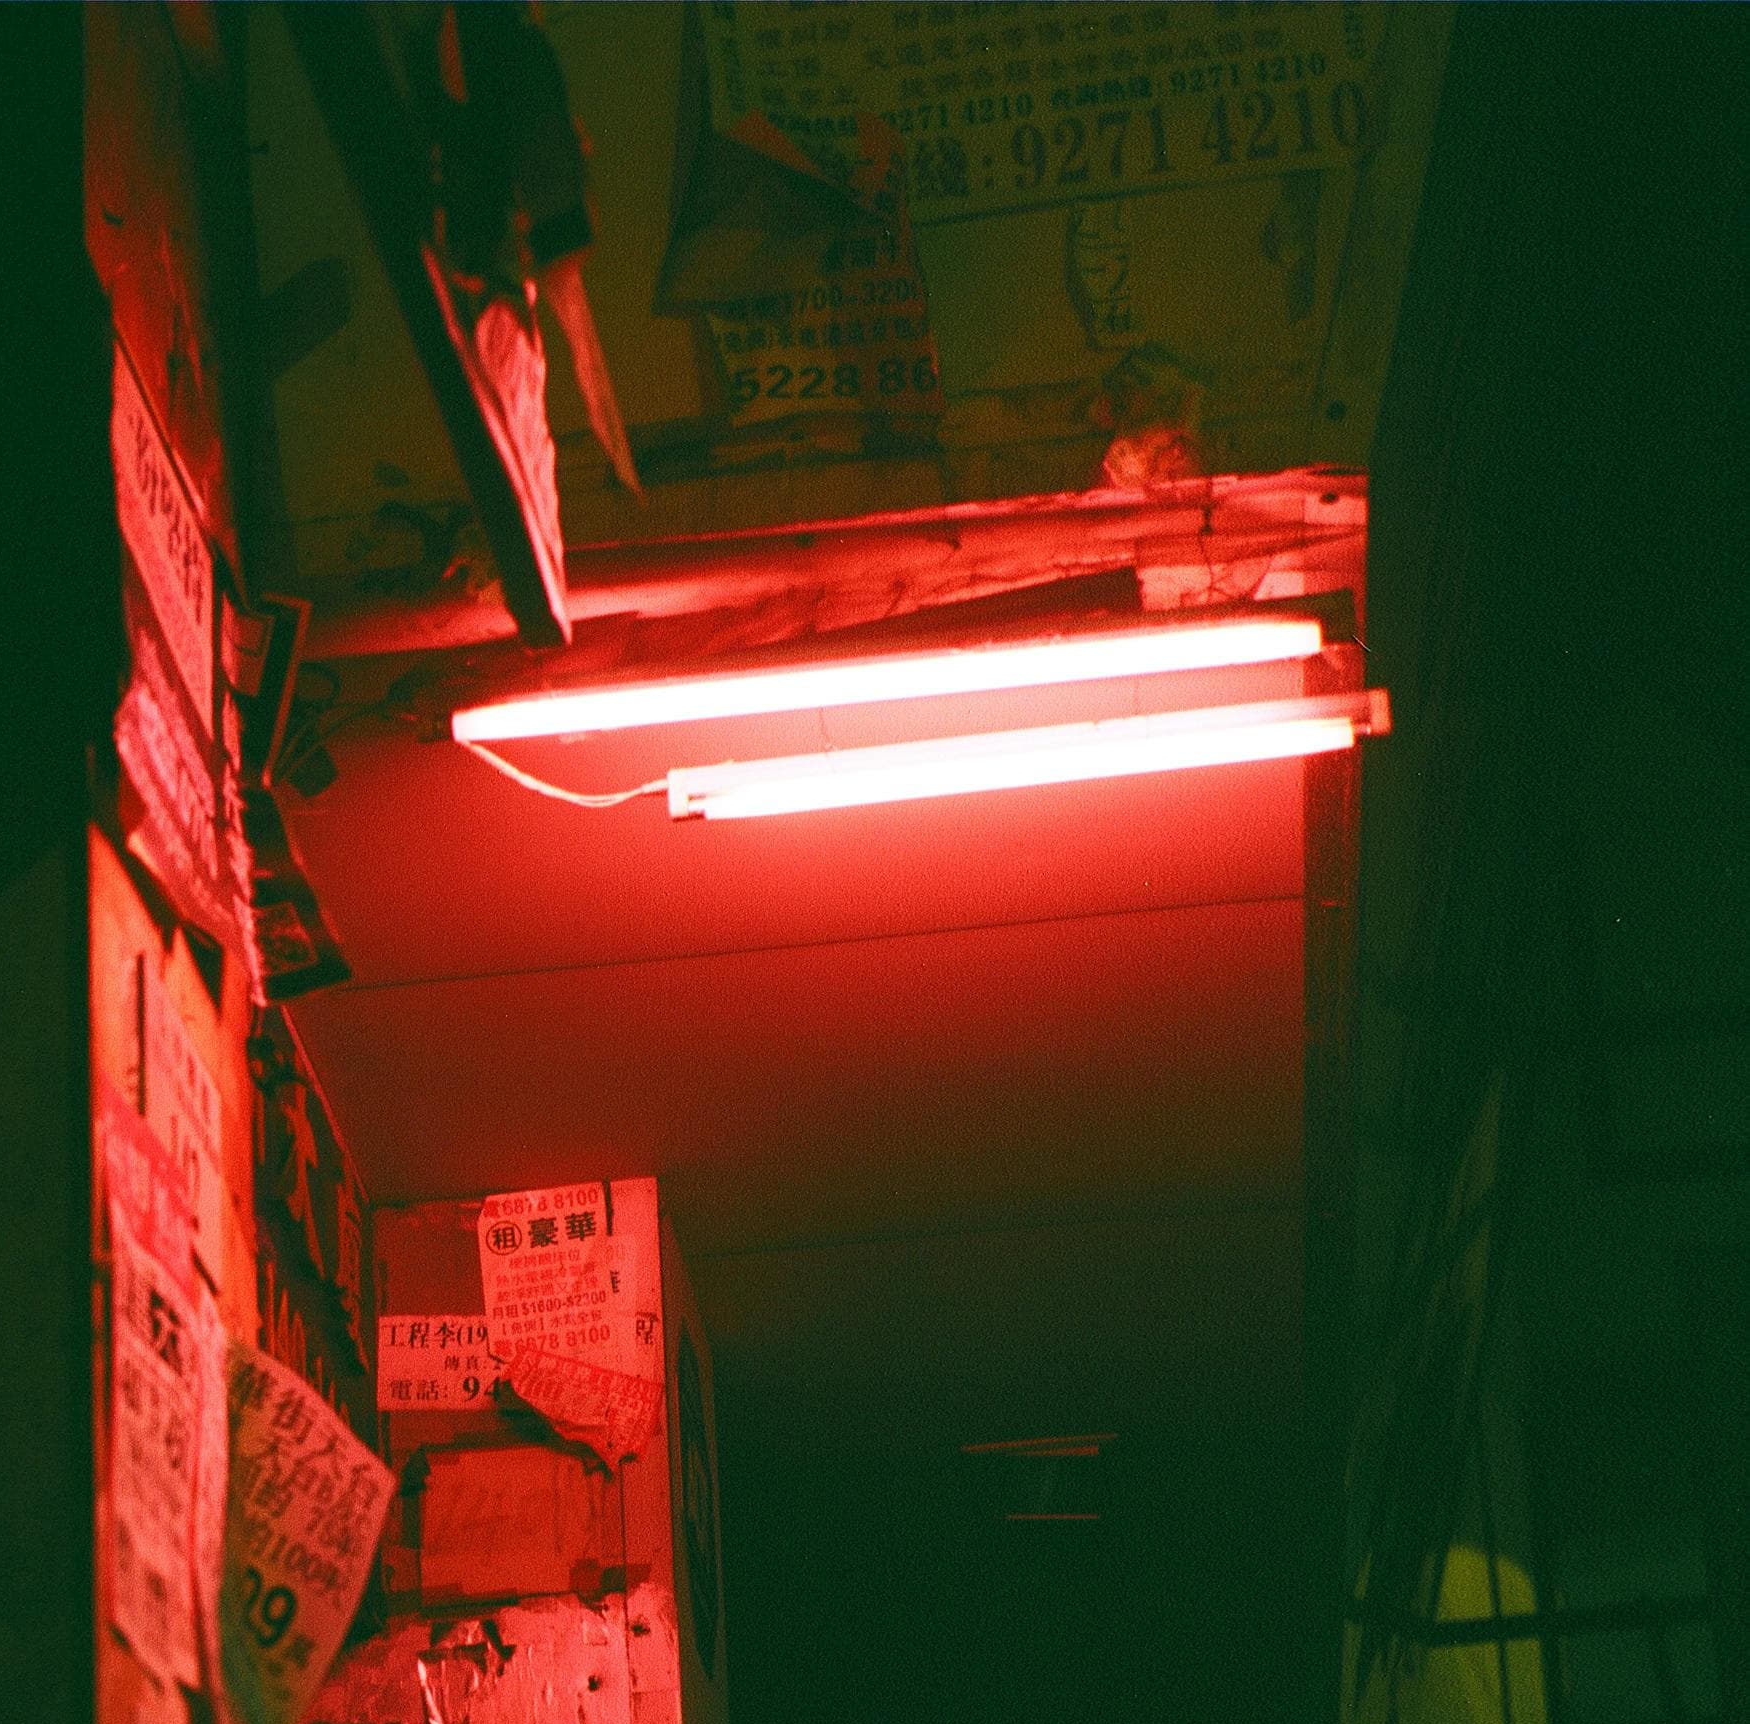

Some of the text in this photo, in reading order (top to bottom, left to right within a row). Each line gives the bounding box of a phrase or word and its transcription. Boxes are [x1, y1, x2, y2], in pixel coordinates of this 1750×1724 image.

[1008, 104, 1176, 190] 9271
[1200, 80, 1369, 167] 4210
[731, 363, 861, 403] 5228
[553, 1187, 600, 1210] 8100
[565, 1324, 611, 1348] 8100
